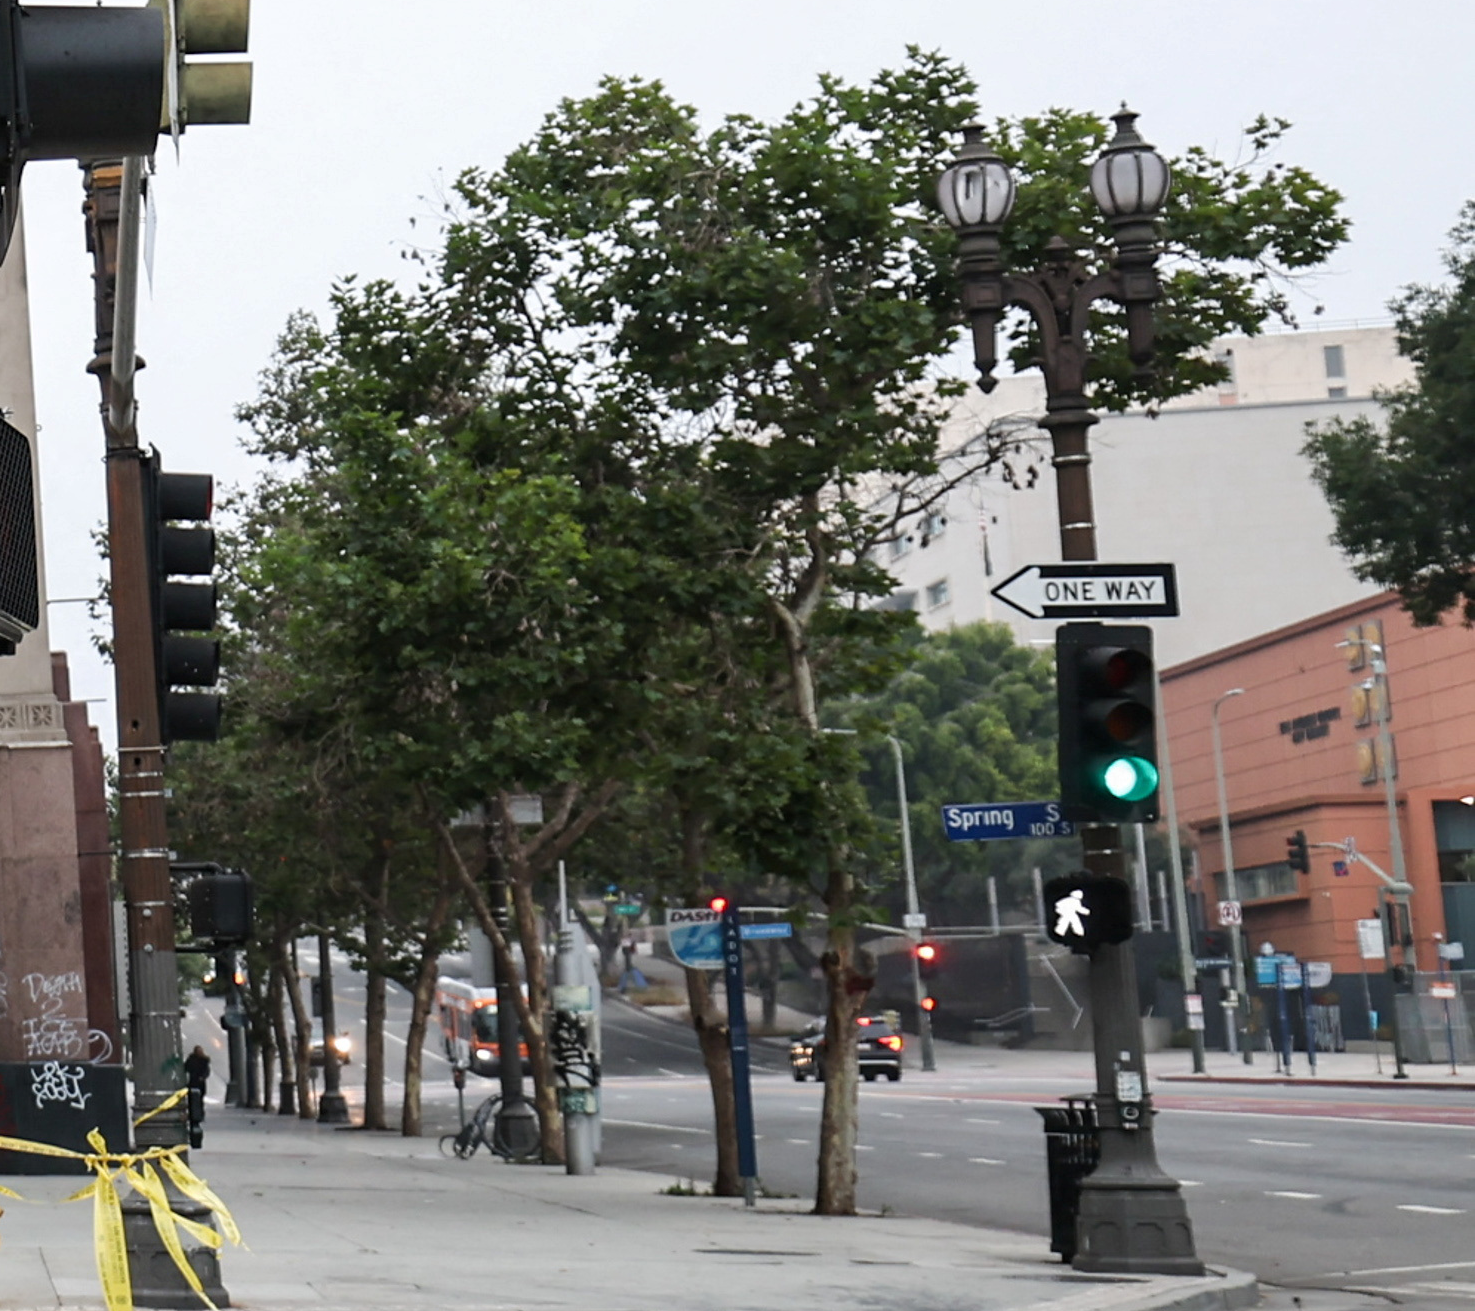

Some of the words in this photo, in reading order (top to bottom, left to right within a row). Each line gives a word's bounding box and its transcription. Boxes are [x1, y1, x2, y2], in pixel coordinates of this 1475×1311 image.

[1044, 582, 1095, 602] ONE
[1105, 581, 1159, 602] WAY
[948, 808, 1014, 830] Spring
[1045, 804, 1061, 822] S
[1031, 822, 1055, 835] 100
